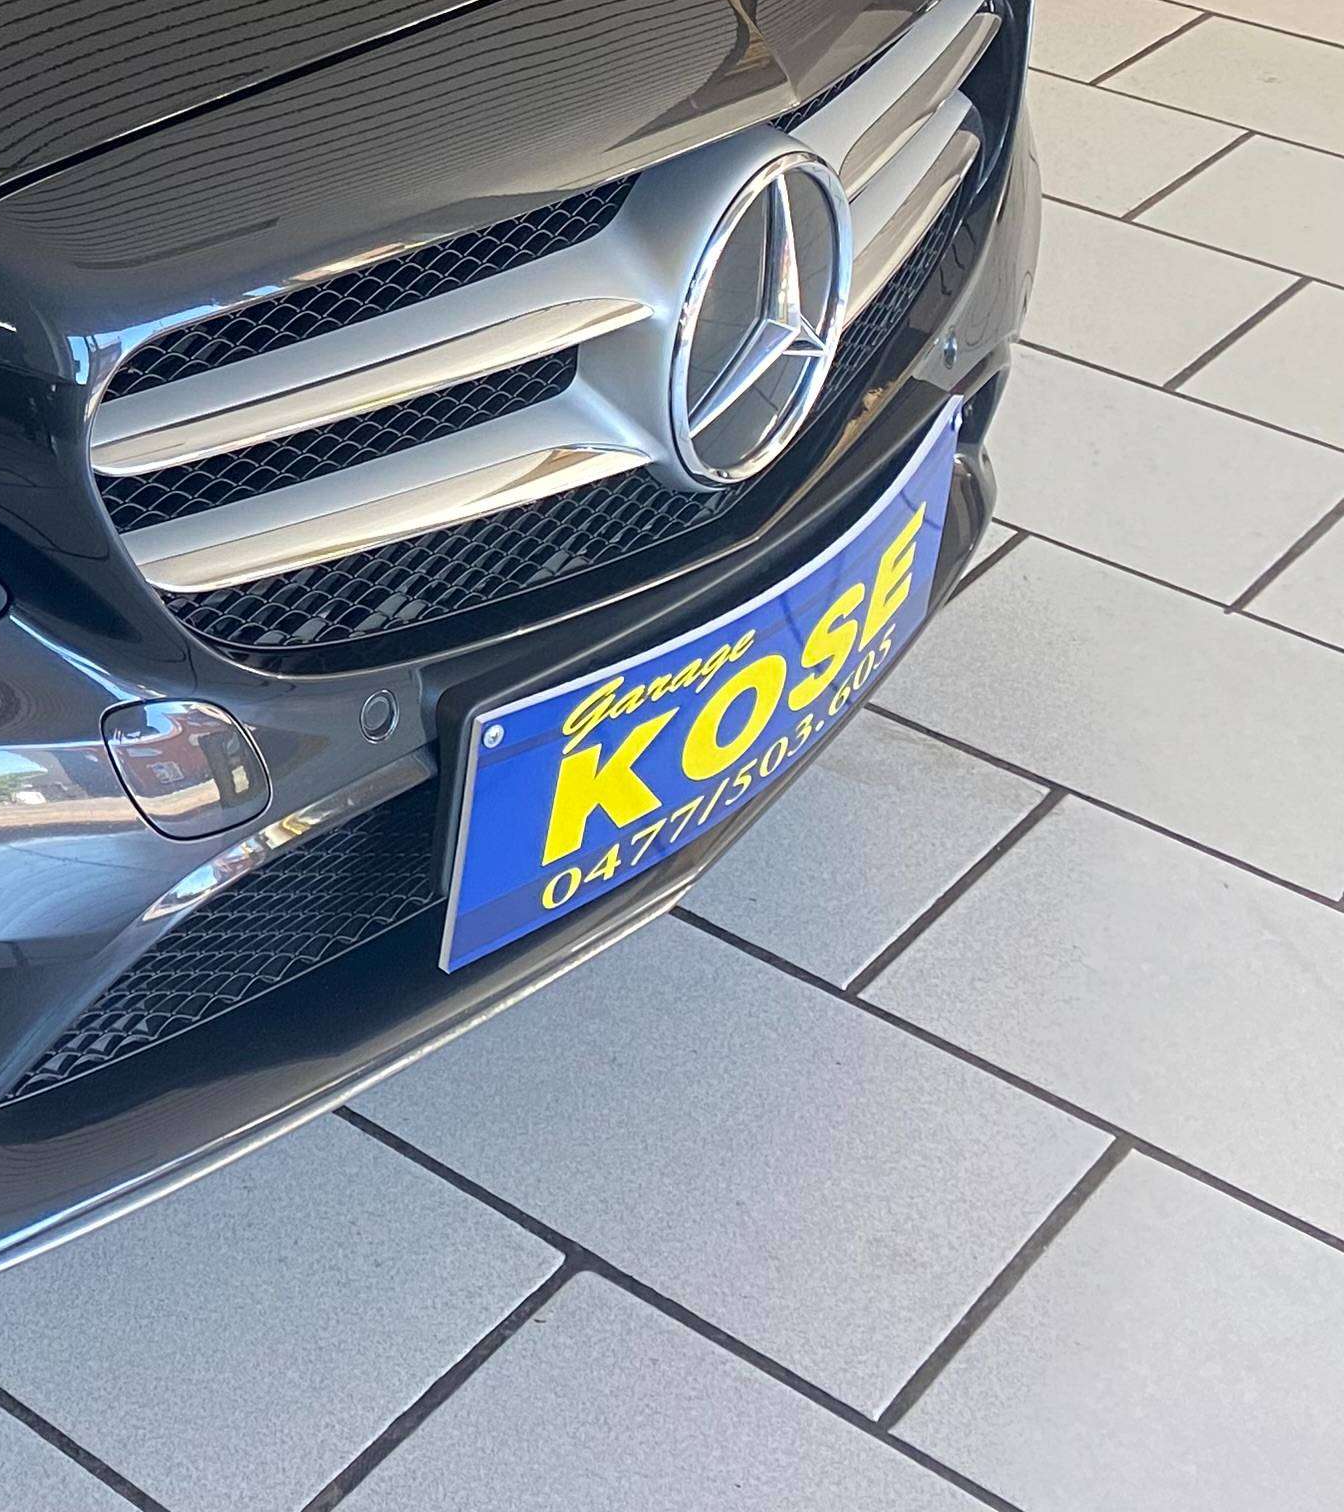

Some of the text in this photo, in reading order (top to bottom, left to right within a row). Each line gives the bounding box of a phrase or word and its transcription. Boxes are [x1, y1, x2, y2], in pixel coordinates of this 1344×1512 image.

[541, 624, 892, 910] 0477/503.605
[542, 501, 927, 867] KOSE
[562, 629, 756, 755] Garage
